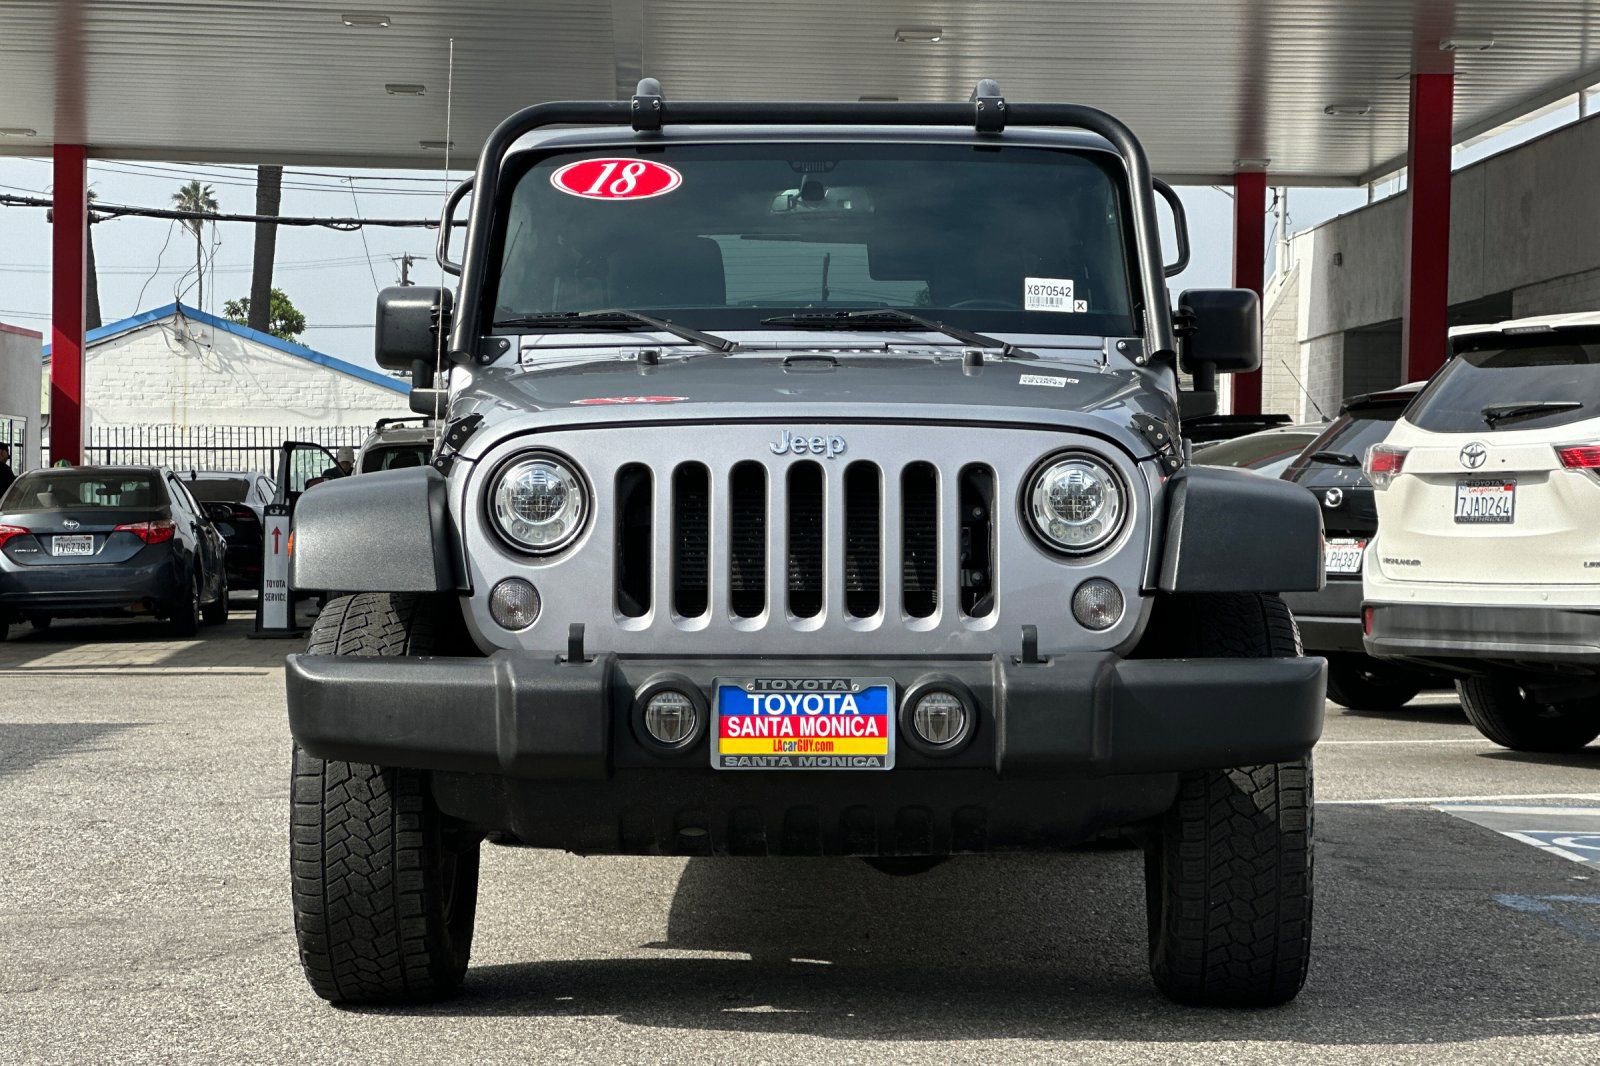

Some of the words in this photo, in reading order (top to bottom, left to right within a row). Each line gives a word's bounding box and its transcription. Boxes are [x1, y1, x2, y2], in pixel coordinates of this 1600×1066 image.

[582, 162, 646, 195] 18
[1027, 284, 1072, 298] X870542
[769, 430, 846, 459] Jeep
[1459, 496, 1510, 517] 7JAD264
[266, 579, 286, 589] TOYOTA
[265, 592, 287, 602] SERVICE
[757, 679, 848, 690] TOYOTA
[747, 693, 859, 715] TOYOTA
[727, 716, 794, 737] SANTA
[800, 716, 879, 737] MONICA
[773, 738, 834, 752] LAcarGUY.com
[725, 756, 793, 767] SANTA
[799, 756, 881, 767] MONICA
